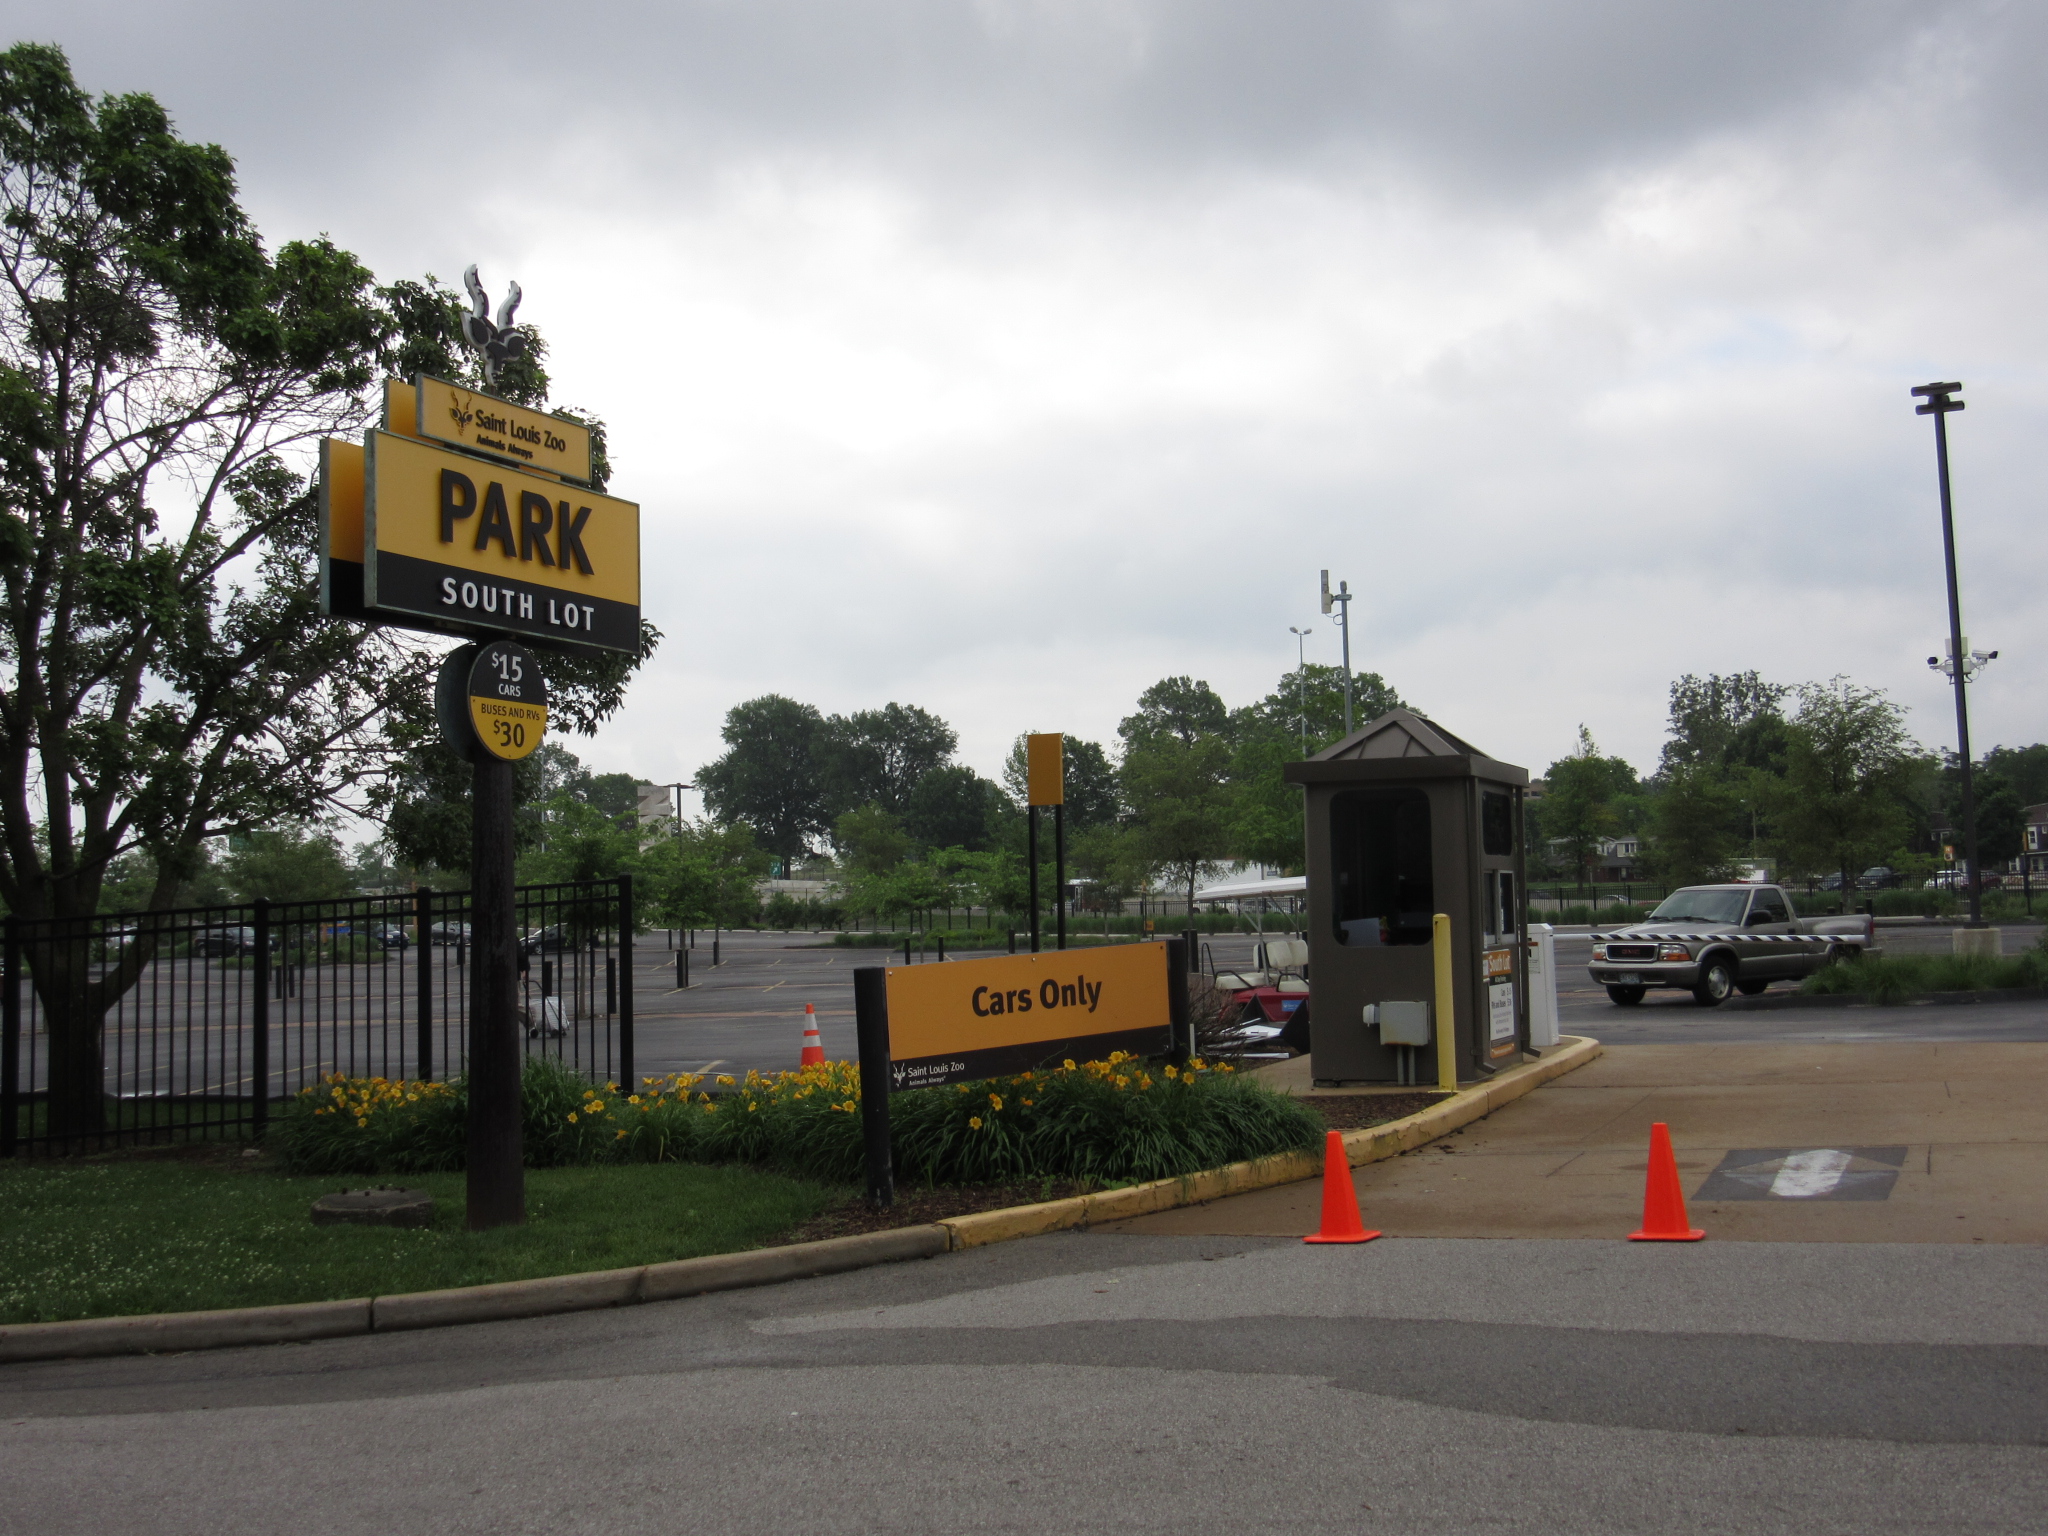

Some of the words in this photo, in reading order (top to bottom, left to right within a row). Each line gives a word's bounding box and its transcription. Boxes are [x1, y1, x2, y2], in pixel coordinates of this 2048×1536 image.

[475, 409, 507, 435] Saint
[510, 419, 541, 445] Louis
[544, 430, 566, 452] Zoo
[476, 434, 506, 451] Animals
[507, 443, 534, 459] Always
[440, 468, 595, 576] PARK
[441, 577, 534, 620] SOUTH
[549, 603, 595, 631] LOT
[491, 651, 523, 682] $15
[498, 683, 521, 697] CARS
[481, 703, 507, 716] BUSES
[508, 707, 524, 718] AND
[526, 710, 540, 721] RVs
[493, 719, 525, 748] $30
[972, 986, 1033, 1017] Cars
[1039, 974, 1102, 1014] Only
[907, 1066, 927, 1078] Saint
[929, 1063, 949, 1074] Louis
[950, 1061, 965, 1072] Zoo
[908, 1079, 927, 1087] Animals
